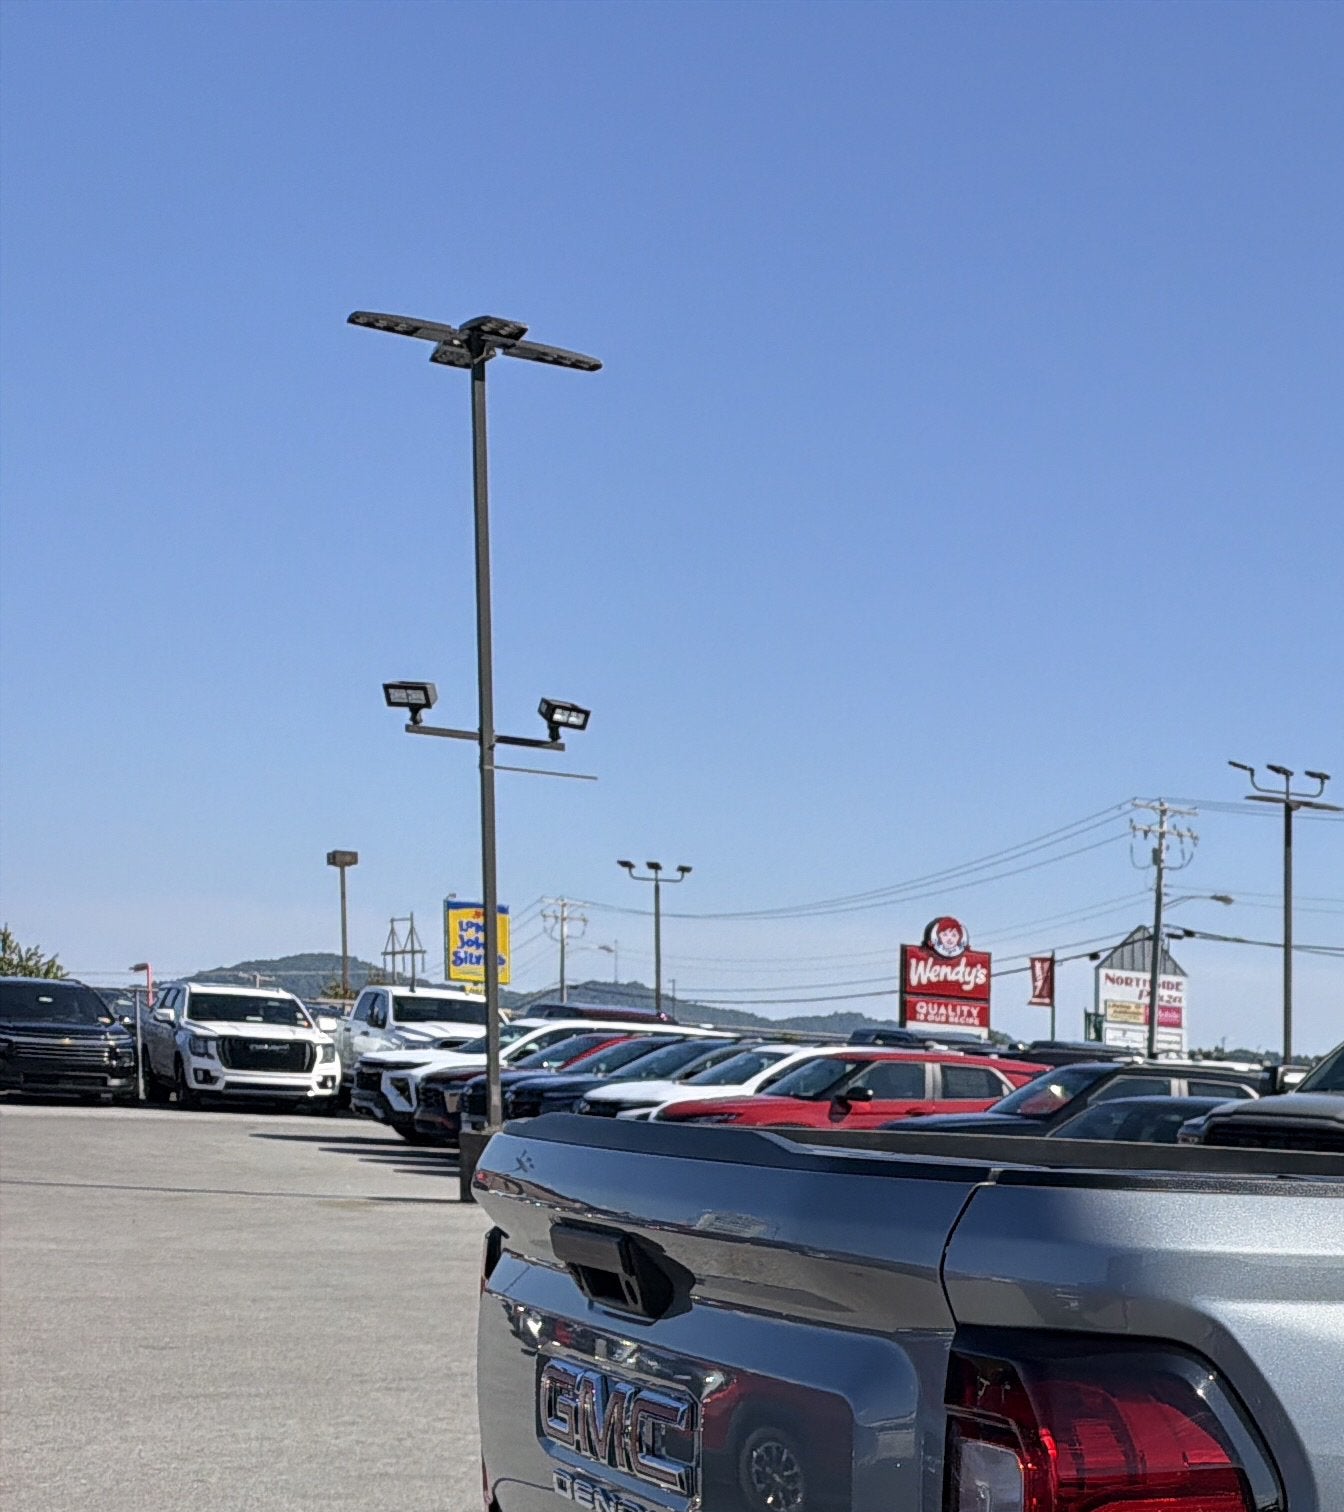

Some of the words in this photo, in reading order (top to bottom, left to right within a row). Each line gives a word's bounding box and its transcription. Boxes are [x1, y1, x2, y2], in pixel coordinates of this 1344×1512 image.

[909, 957, 988, 991] Wendy's
[915, 1001, 981, 1018] QUALITY
[540, 1358, 690, 1497] GMC
